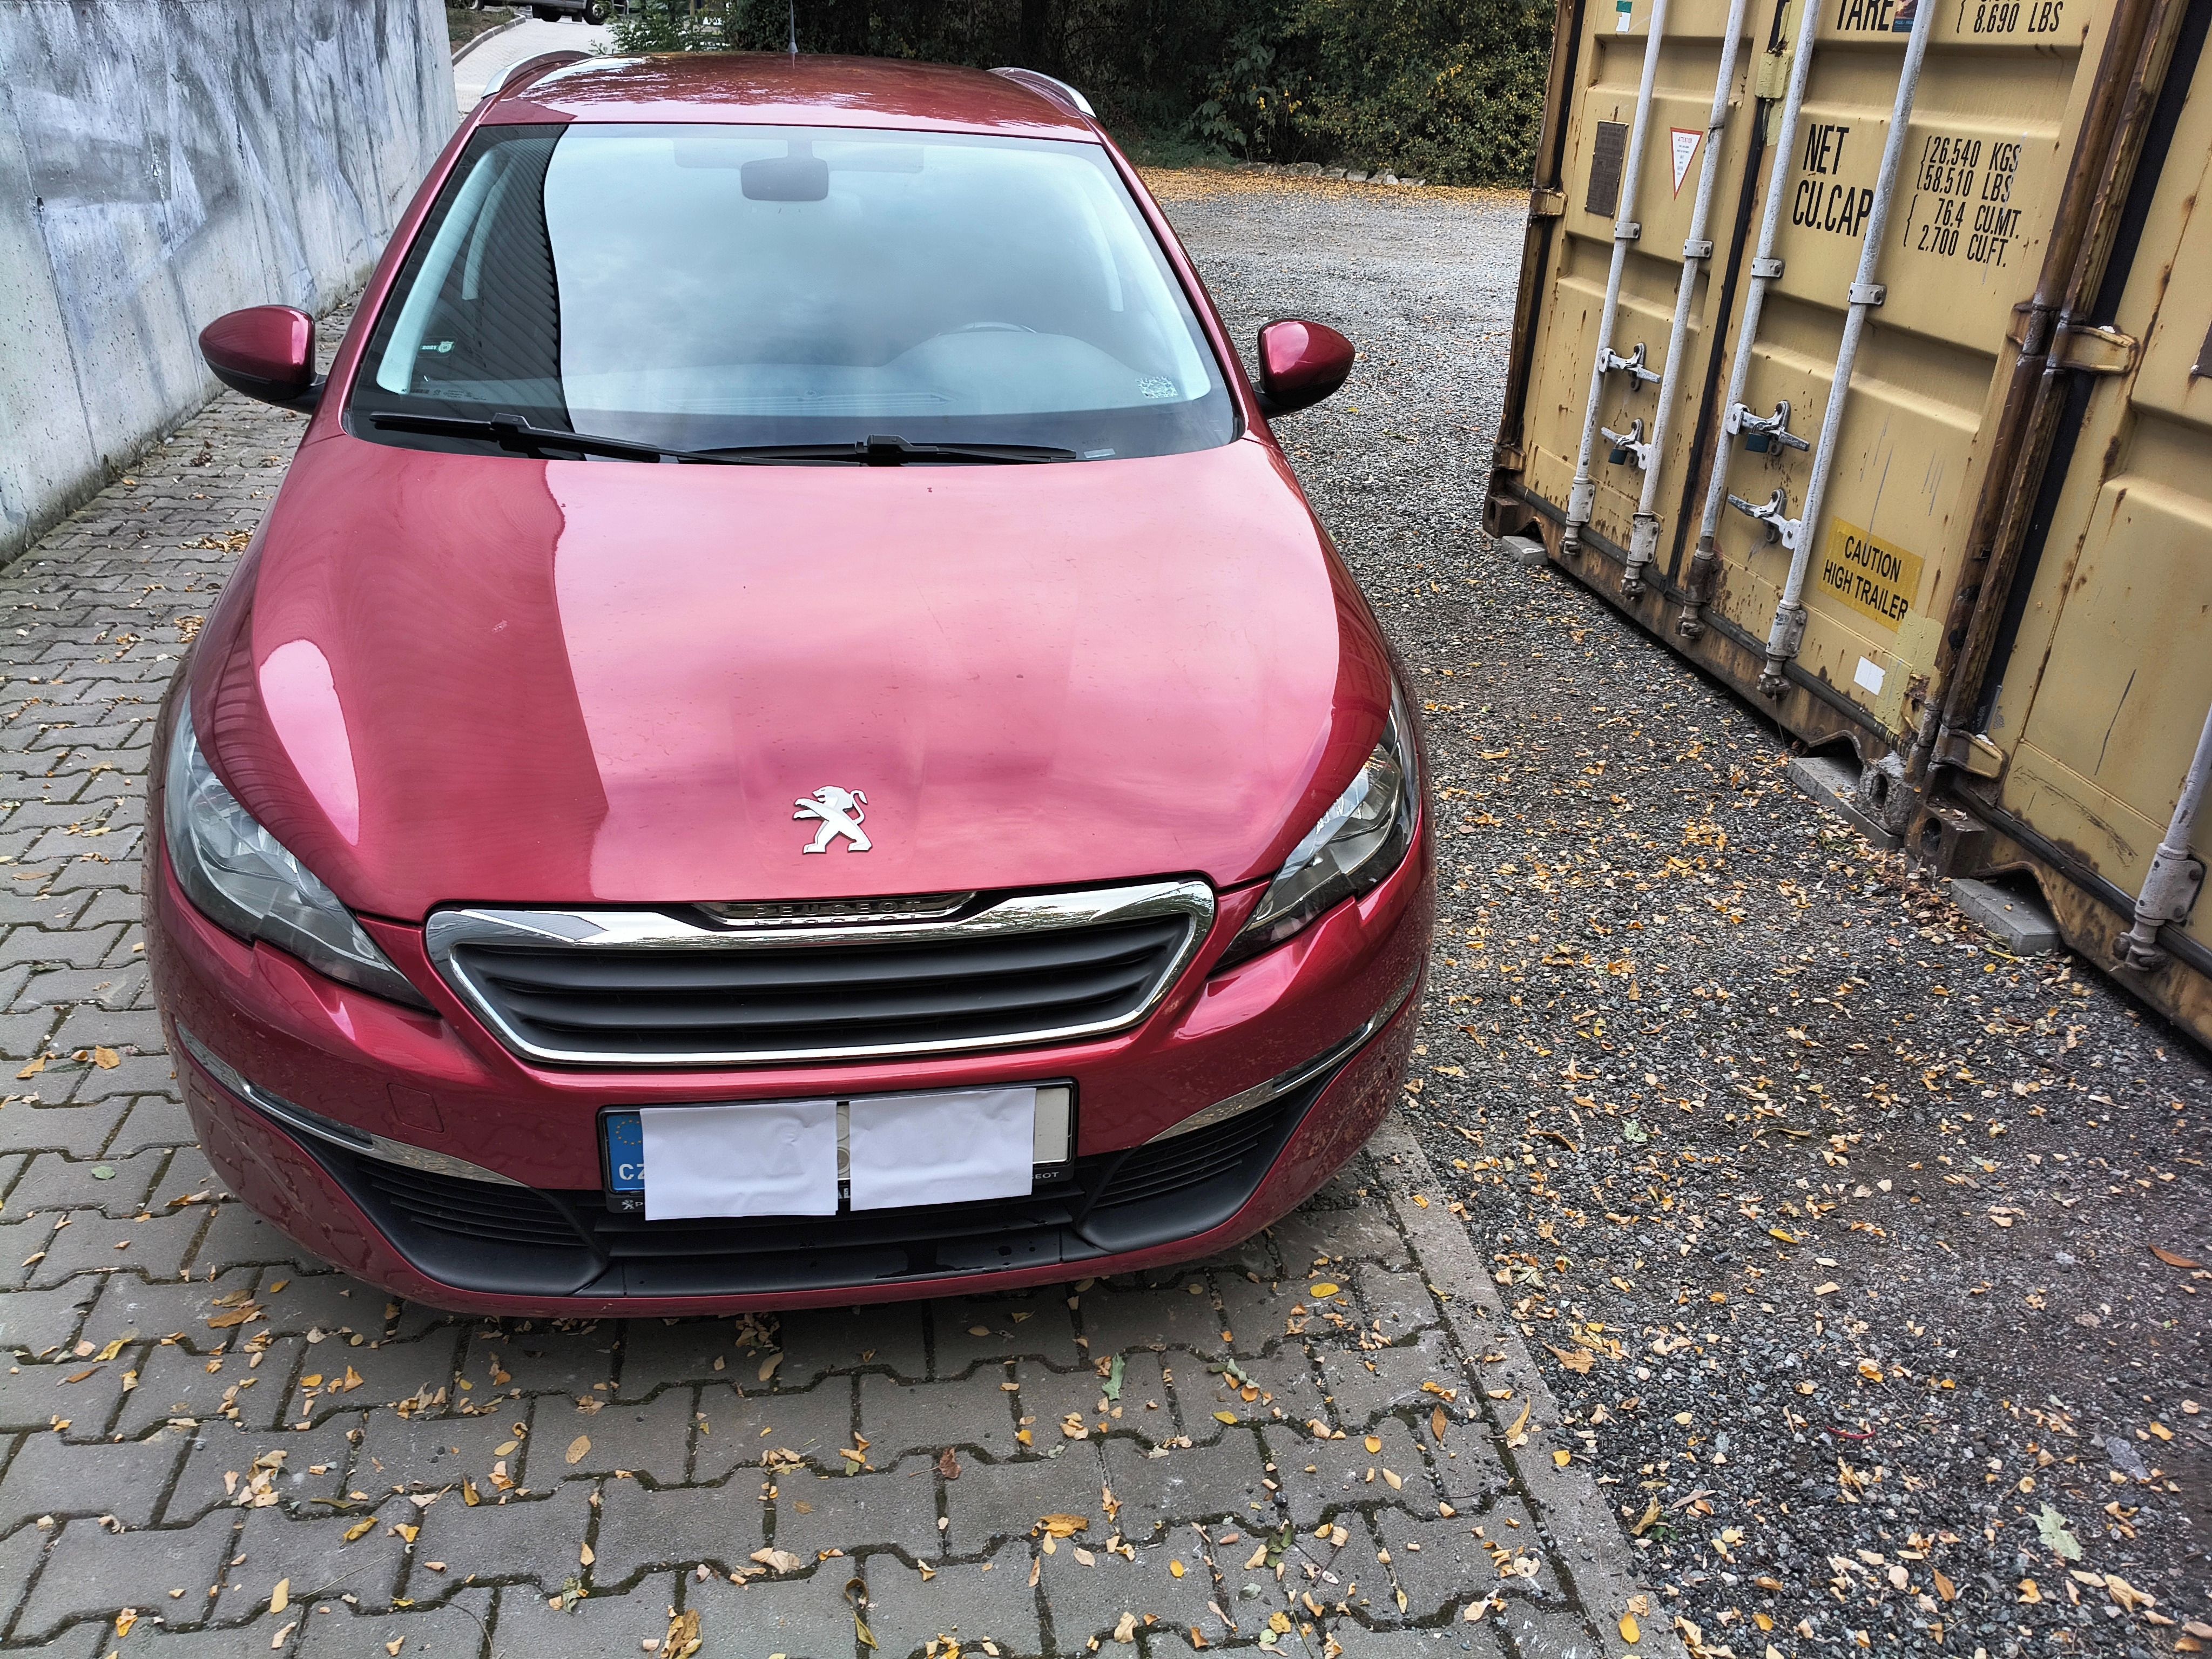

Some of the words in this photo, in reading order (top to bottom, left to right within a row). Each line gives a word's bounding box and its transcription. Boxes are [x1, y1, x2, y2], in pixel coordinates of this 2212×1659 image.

[1973, 3, 2020, 33] 8,690
[2028, 2, 2063, 32] LBS
[1803, 123, 1850, 175] NET
[1930, 136, 1981, 168] 26,540
[1988, 142, 2022, 173] KGS
[1923, 165, 1974, 197] 58,510
[1981, 172, 2014, 203] LBS
[1934, 198, 1966, 228] 76.4
[1974, 204, 2022, 239] CU.MT.
[1967, 233, 2009, 267] CU.FT.
[1844, 536, 1901, 583] CAUTION
[1823, 559, 1853, 594] HIGH
[1854, 575, 1908, 621] TRAILER
[754, 901, 920, 918] PEUGEOT
